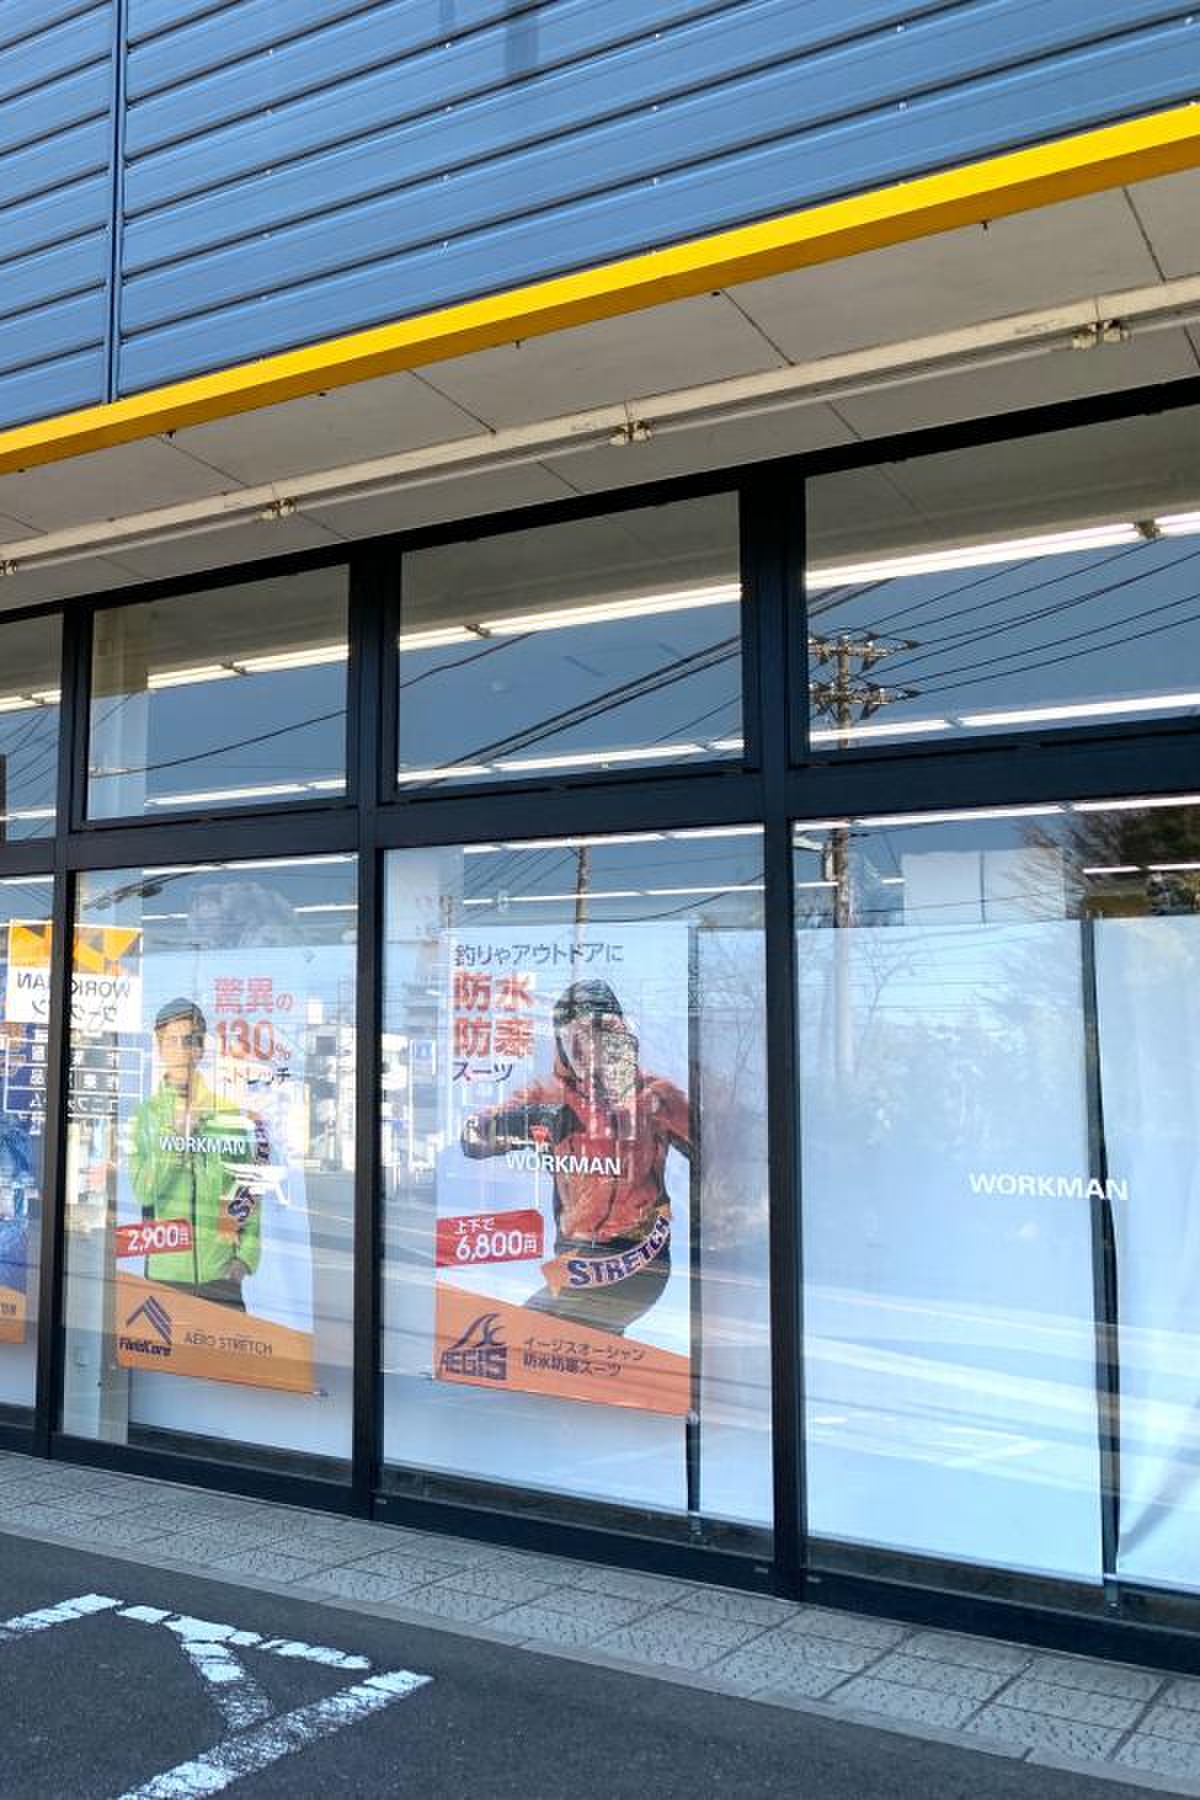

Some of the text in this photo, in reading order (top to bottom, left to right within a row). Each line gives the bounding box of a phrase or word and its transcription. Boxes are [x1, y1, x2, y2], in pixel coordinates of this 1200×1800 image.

[454, 942, 624, 967] 釣りやアウトドアに
[452, 970, 535, 1011] 防水
[452, 1018, 535, 1059] 防寒
[452, 1061, 513, 1082] スーツ
[160, 1135, 248, 1155] WORKMAN
[506, 1153, 622, 1177] WORKMAN
[969, 1172, 1129, 1202] WORKMAN
[455, 1218, 495, 1235] 上下で
[455, 1232, 538, 1261] 6,800円
[219, 1335, 273, 1356] STRETCH
